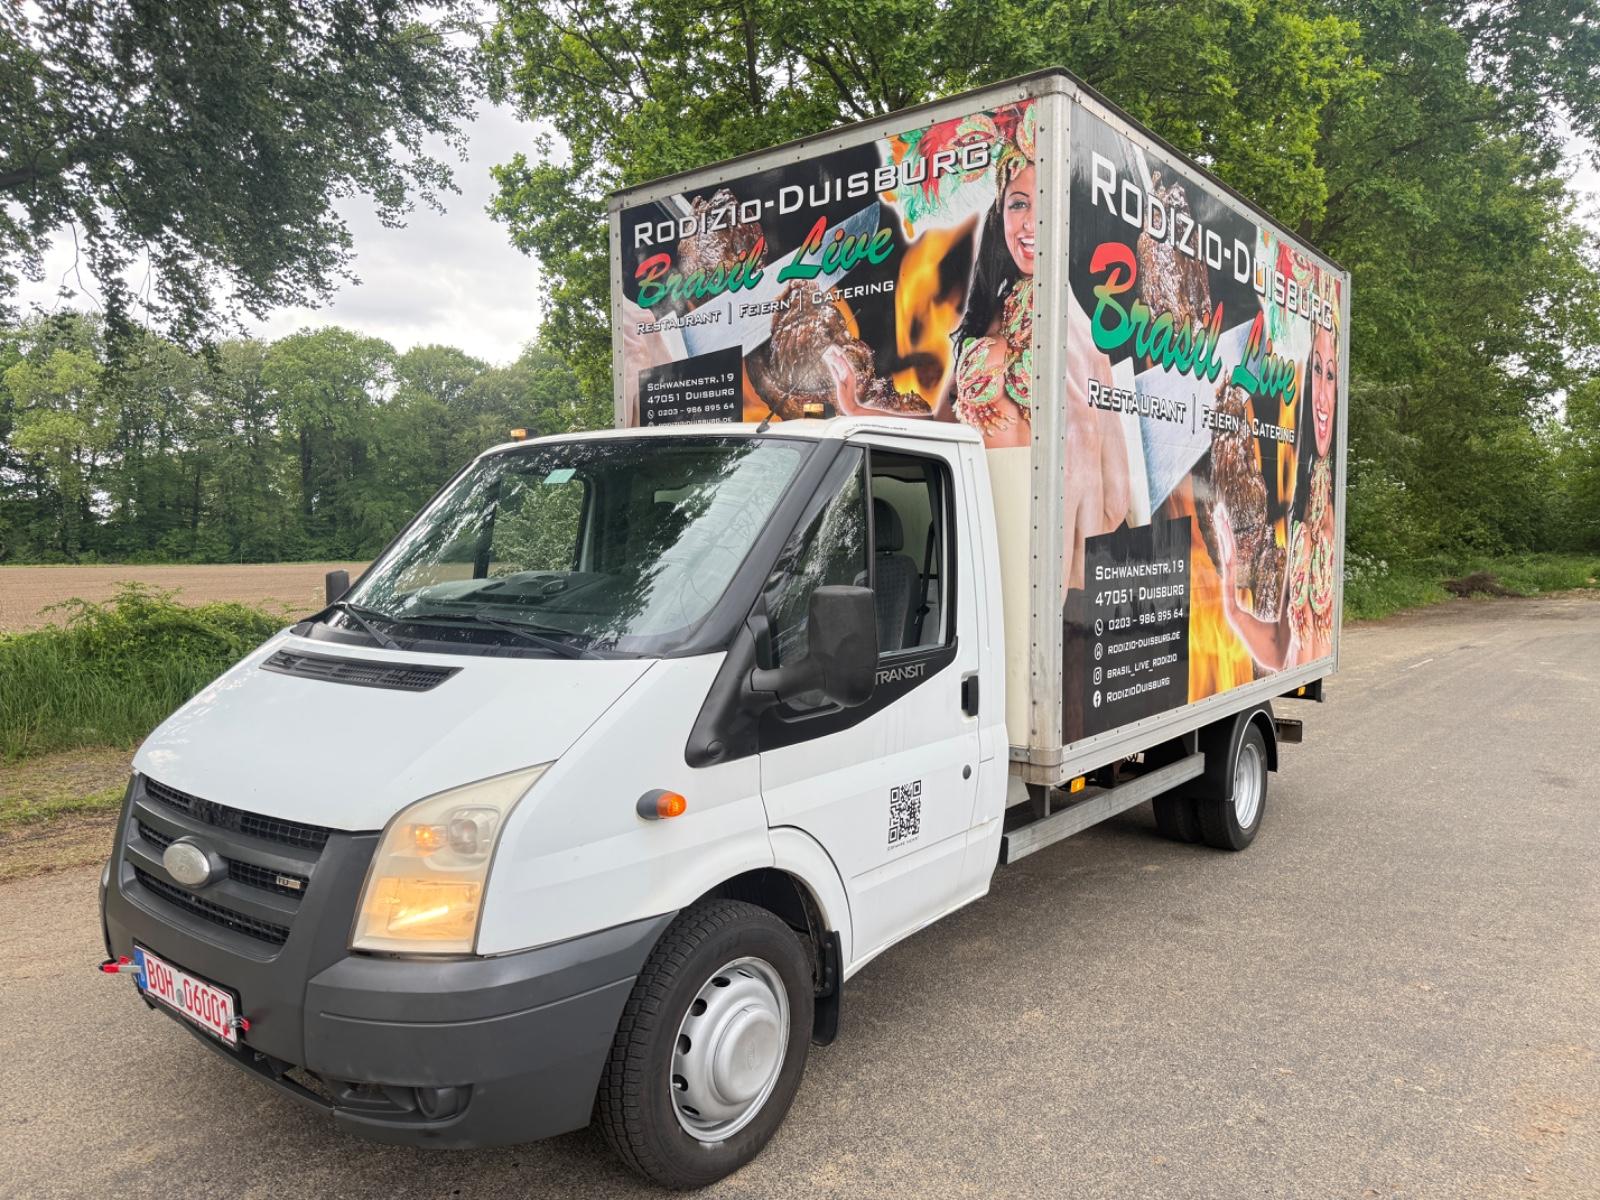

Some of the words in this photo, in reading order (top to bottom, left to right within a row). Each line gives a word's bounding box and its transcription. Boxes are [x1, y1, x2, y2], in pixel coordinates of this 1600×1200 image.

[634, 141, 991, 248] RODIZIO-DUISBURG
[635, 236, 765, 309] Brasil
[777, 215, 895, 281] Live
[1091, 151, 1333, 331] RODIZIO-DUISBURG
[636, 310, 721, 335] RESTAURANT
[812, 280, 894, 304] CATERING
[1089, 242, 1223, 381] Brasil
[1231, 309, 1297, 406] Live
[647, 393, 680, 404] 47051
[685, 388, 735, 400] DUISBURG
[658, 408, 678, 417] 0203
[686, 406, 702, 414] 986
[704, 404, 721, 412] 895
[723, 402, 734, 410] 64
[1087, 378, 1187, 424] RESTAURANT
[1201, 404, 1239, 432] FEIERN
[1252, 418, 1295, 443] CATERING
[1095, 589, 1133, 606] 47051
[1138, 585, 1184, 600] DUISBURG
[1108, 617, 1131, 631] 0203
[1139, 613, 1155, 625] 986
[1157, 611, 1172, 622] 895
[1173, 608, 1184, 619] 64
[875, 663, 926, 685] TRANSIT
[146, 958, 175, 1001] BOH
